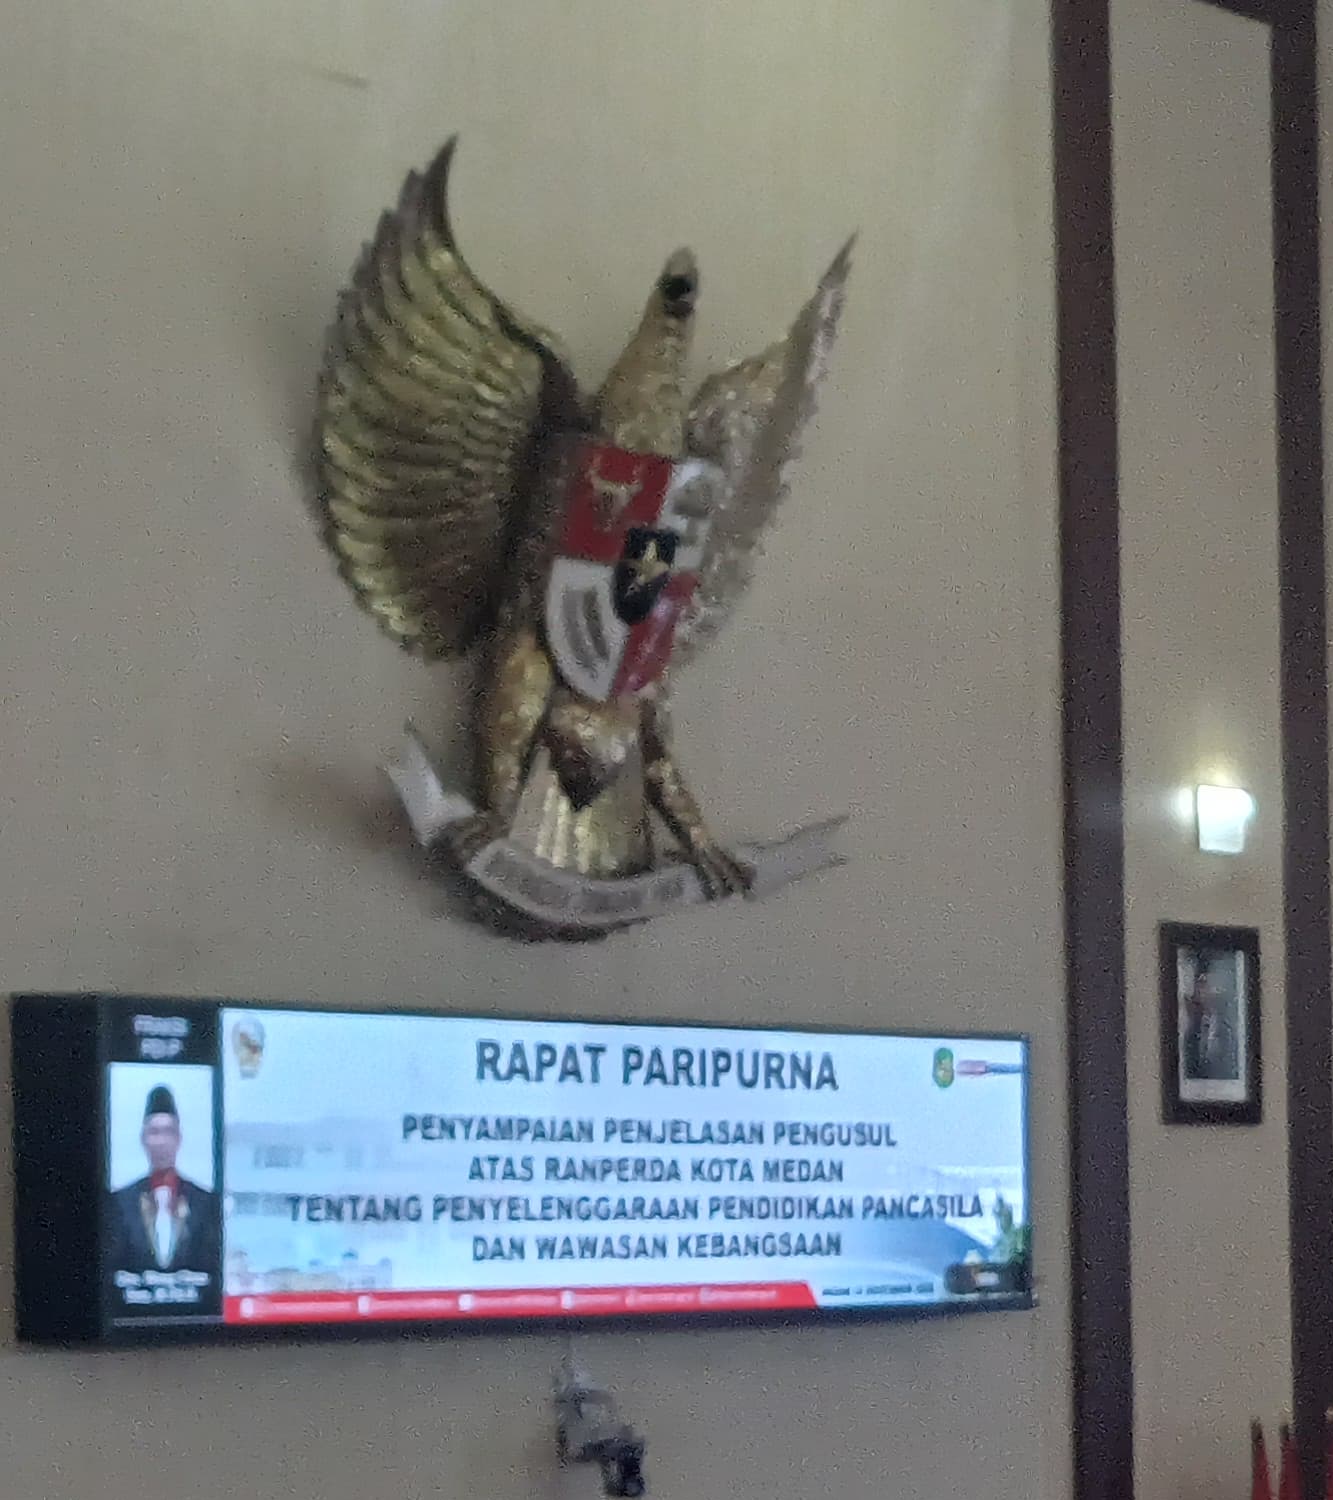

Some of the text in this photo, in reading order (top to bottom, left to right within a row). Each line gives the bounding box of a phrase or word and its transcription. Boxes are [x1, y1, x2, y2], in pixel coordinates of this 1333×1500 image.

[475, 1038, 840, 1092] RAPAT PARIPURNA
[401, 1112, 899, 1149] PENYAMPAIAN PENJELASAN PENGUSUL
[467, 1154, 844, 1185] ATAS RANPERDA KOTA MEDAN
[289, 1193, 984, 1224] TENTANG PENYELENGGARAAN PENDIDIKAN PANCASILA
[472, 1231, 843, 1263] DAN WAWASAN KEBANGSAAN
